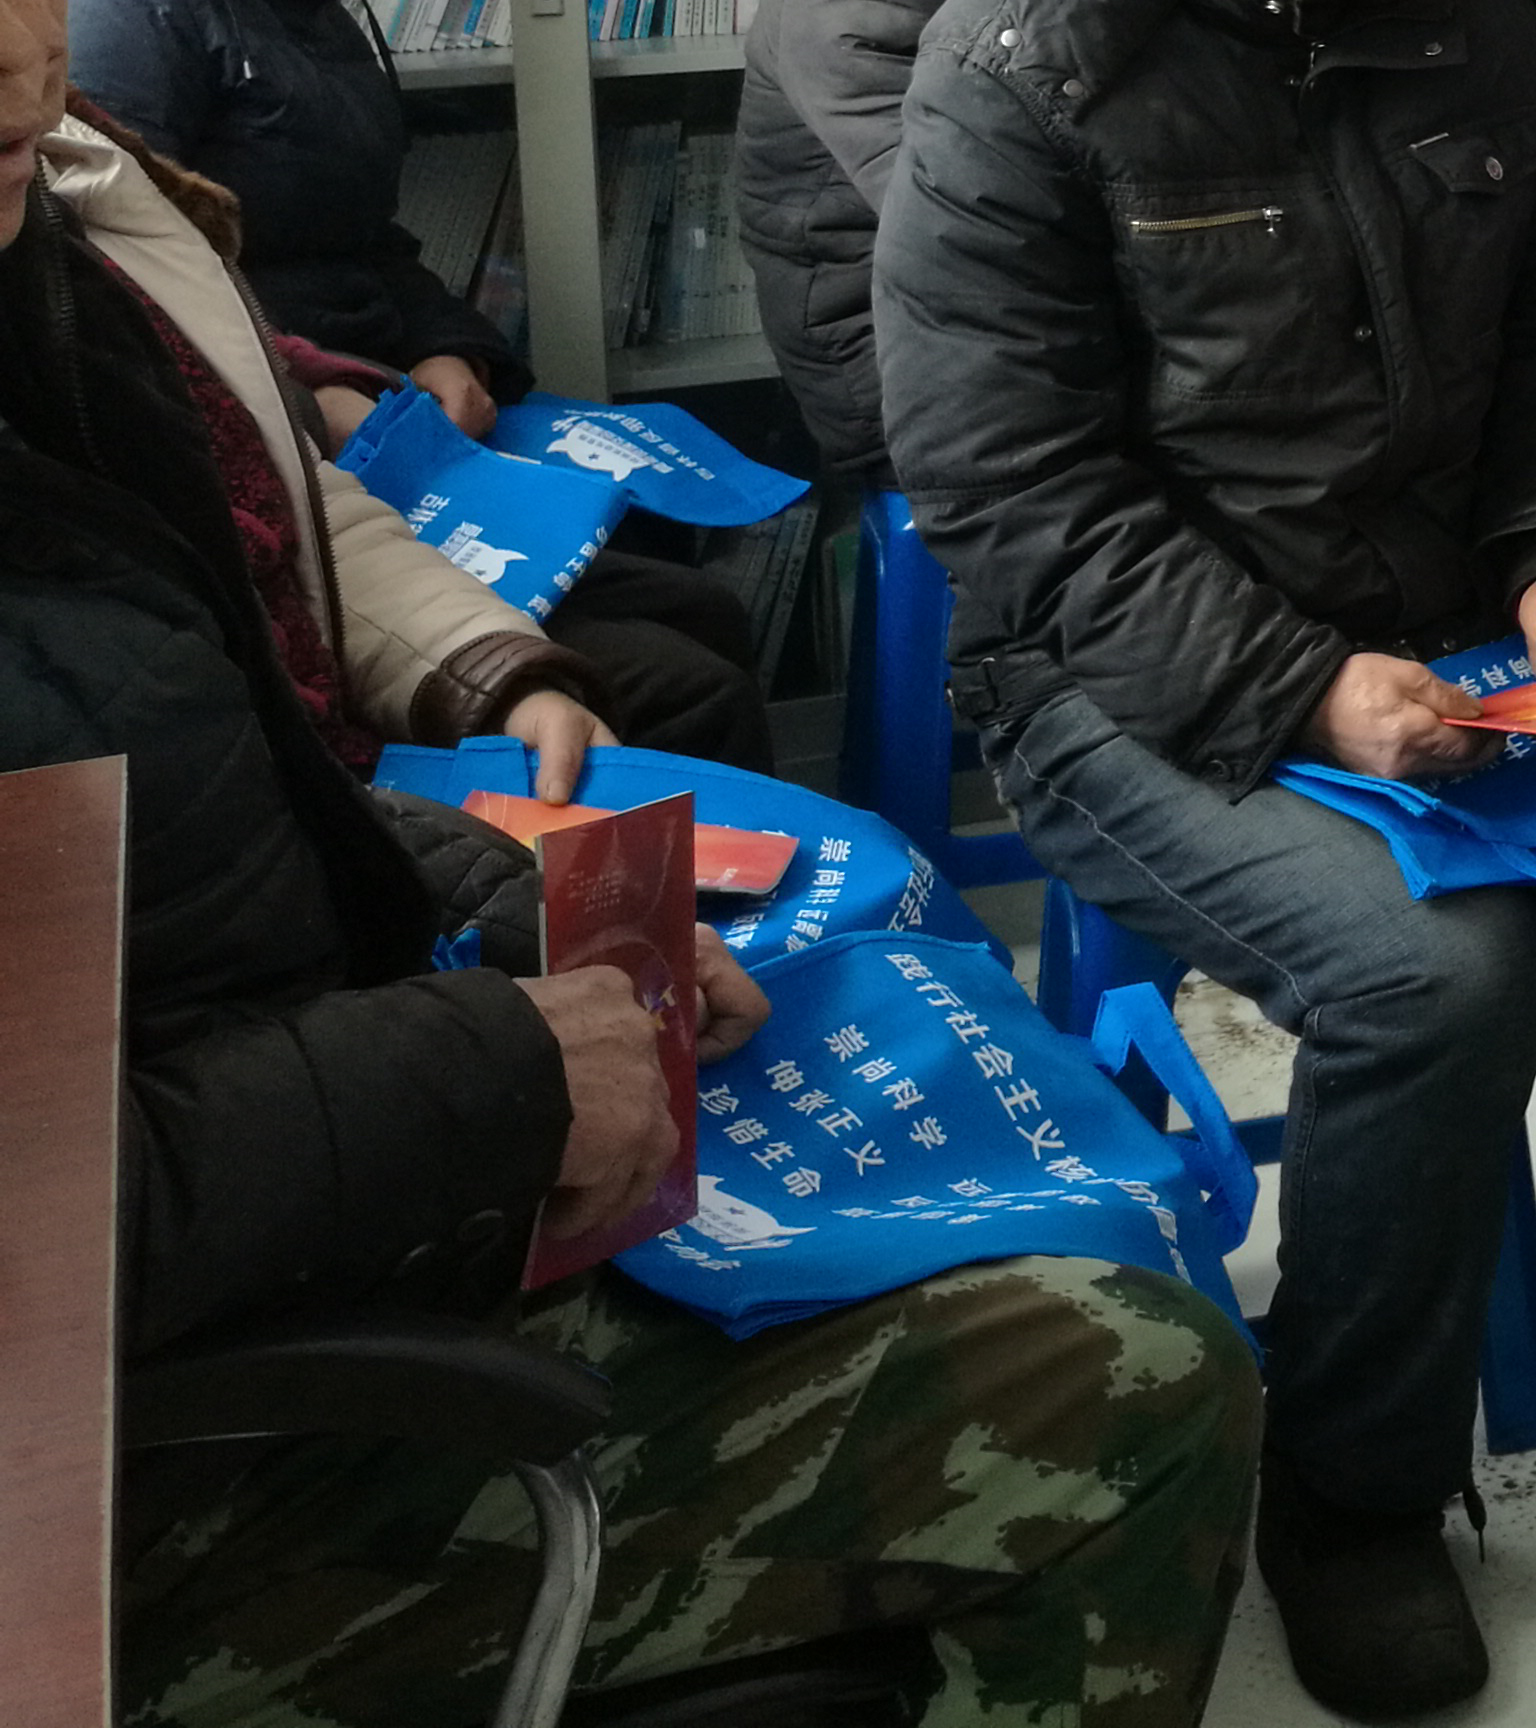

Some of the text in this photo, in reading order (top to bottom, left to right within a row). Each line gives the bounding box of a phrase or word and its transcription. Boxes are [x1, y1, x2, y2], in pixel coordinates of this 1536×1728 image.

[697, 1083, 823, 1199] 珍惜生命
[764, 1058, 887, 1177] 伸张正义
[822, 1023, 948, 1151] 崇尚科学
